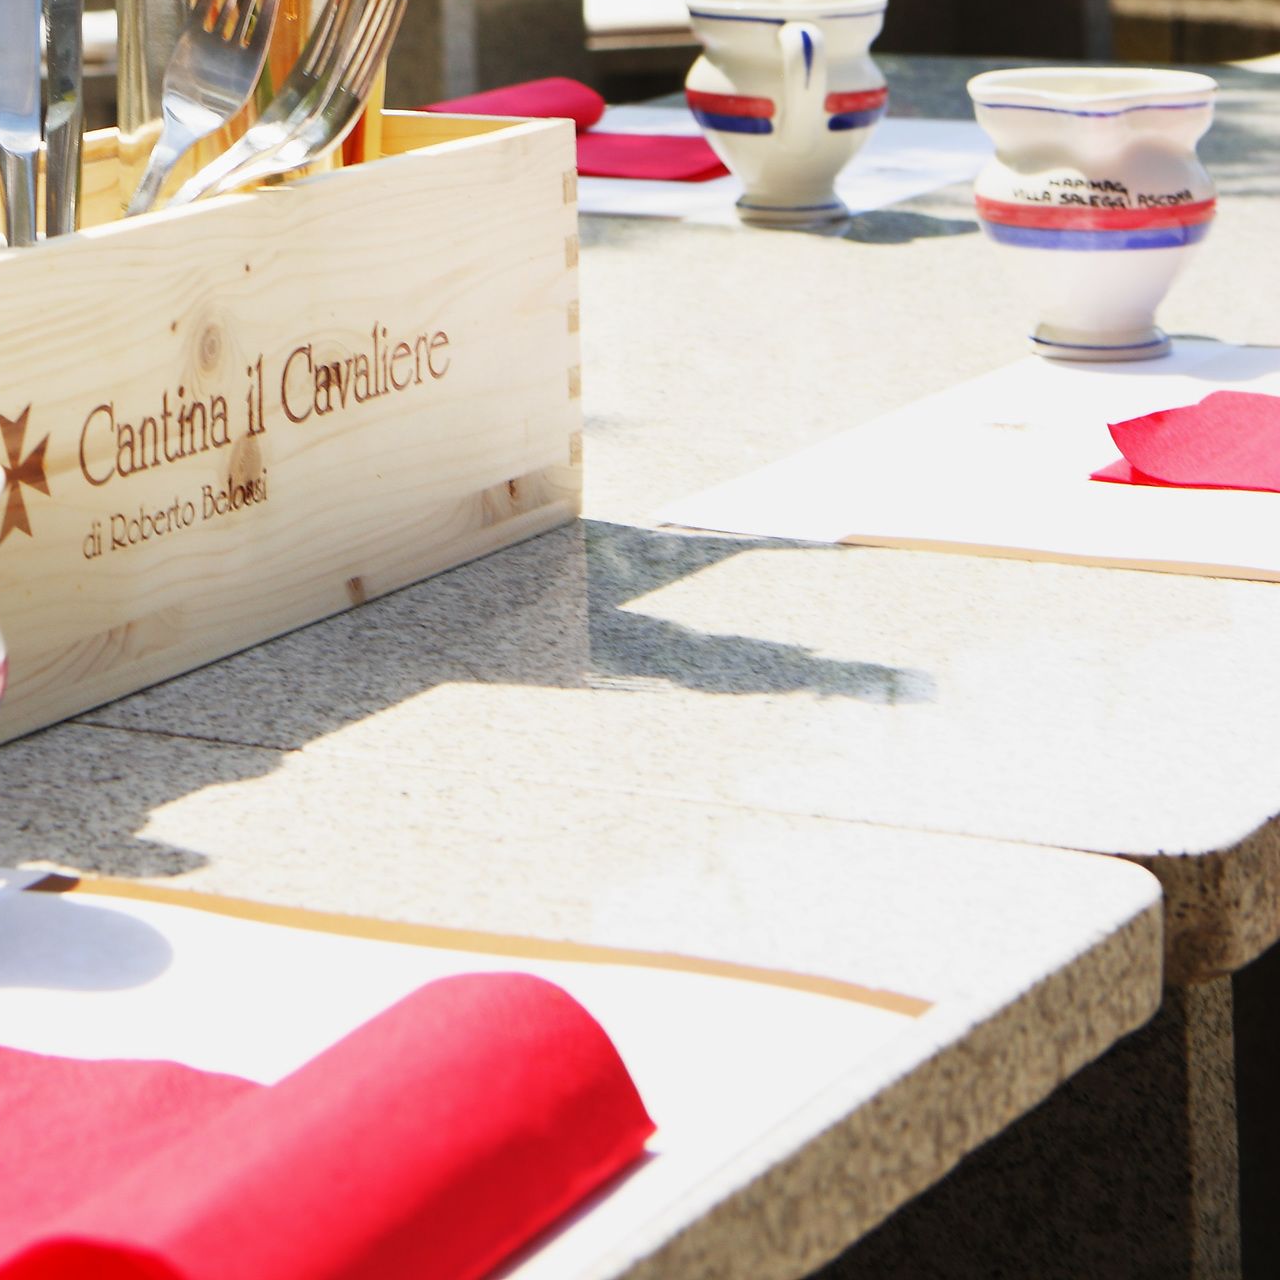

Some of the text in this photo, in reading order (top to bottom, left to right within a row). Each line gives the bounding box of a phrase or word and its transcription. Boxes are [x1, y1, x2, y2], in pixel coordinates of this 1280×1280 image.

[78, 320, 452, 487] Cantina il Cavaliere
[82, 521, 103, 560] di
[109, 495, 196, 552] Roberto
